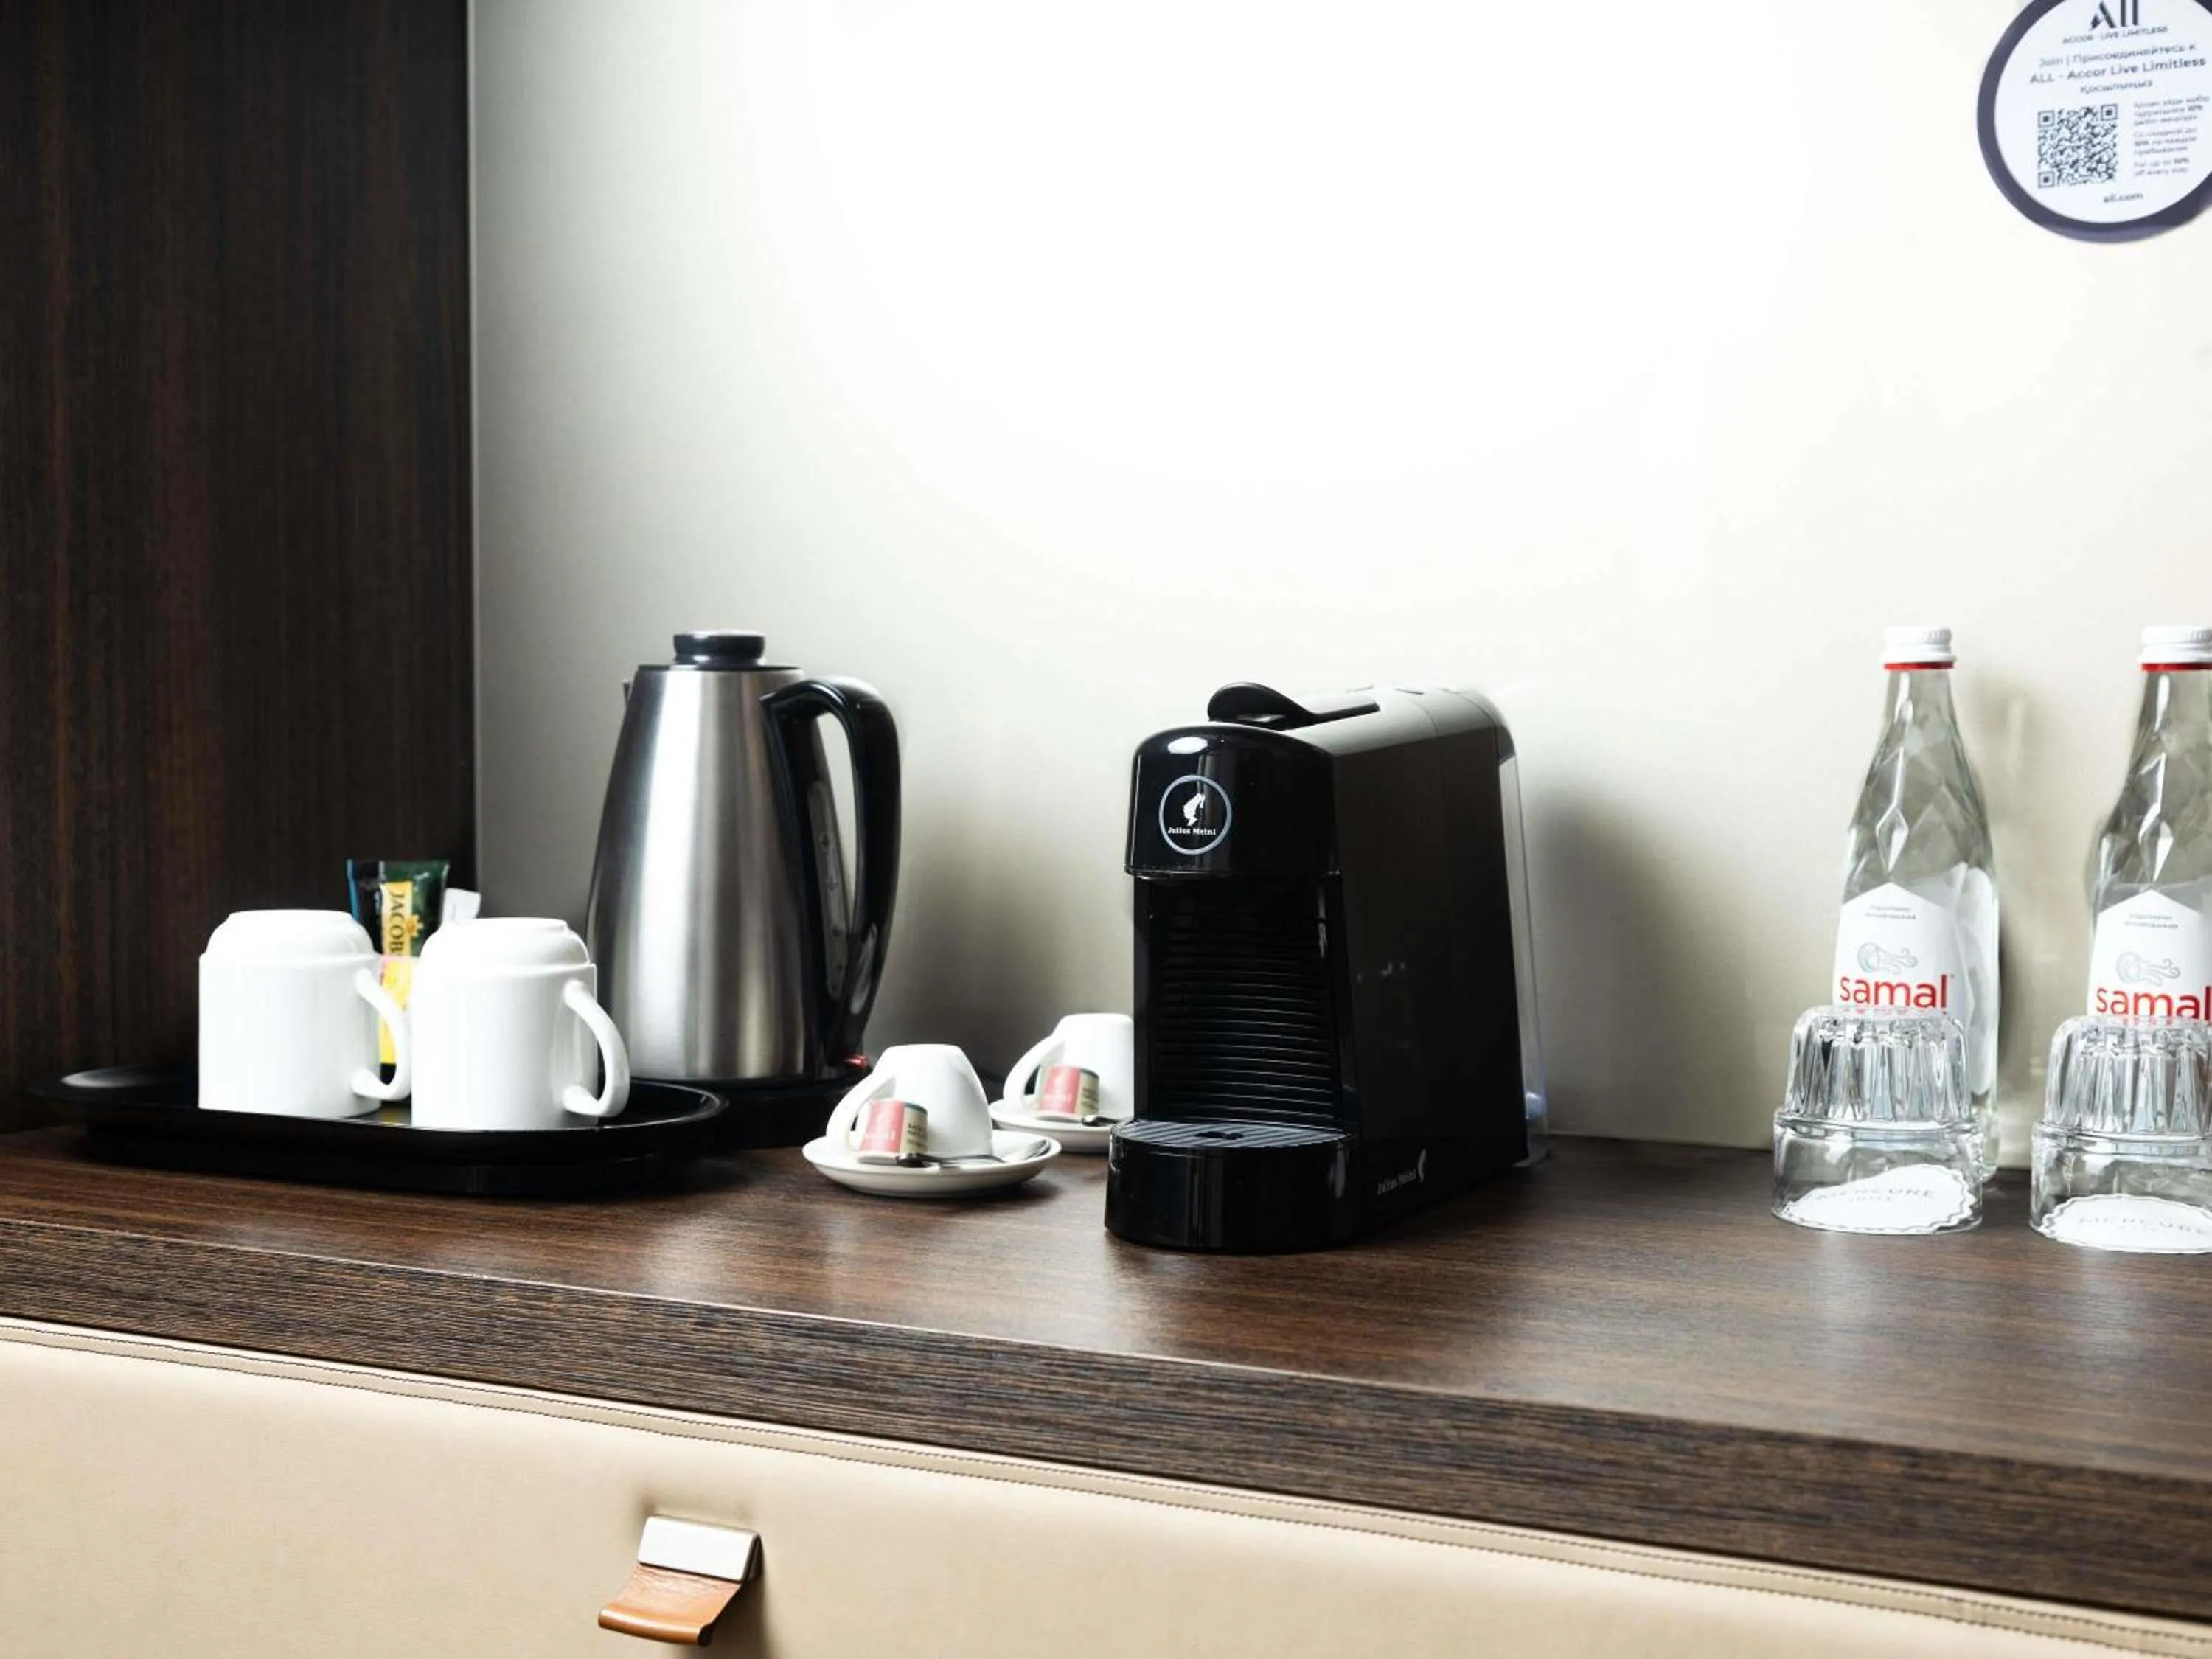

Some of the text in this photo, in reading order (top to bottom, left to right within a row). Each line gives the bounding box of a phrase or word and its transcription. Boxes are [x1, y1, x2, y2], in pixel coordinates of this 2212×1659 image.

[2030, 73, 2054, 83] ALL
[2067, 67, 2107, 80] Accor
[2111, 63, 2138, 75] Live
[2143, 58, 2207, 72] Limitless
[1167, 827, 1217, 835] Julius Meinl
[1839, 973, 1948, 1009] samal
[2096, 984, 2212, 1021] samal
